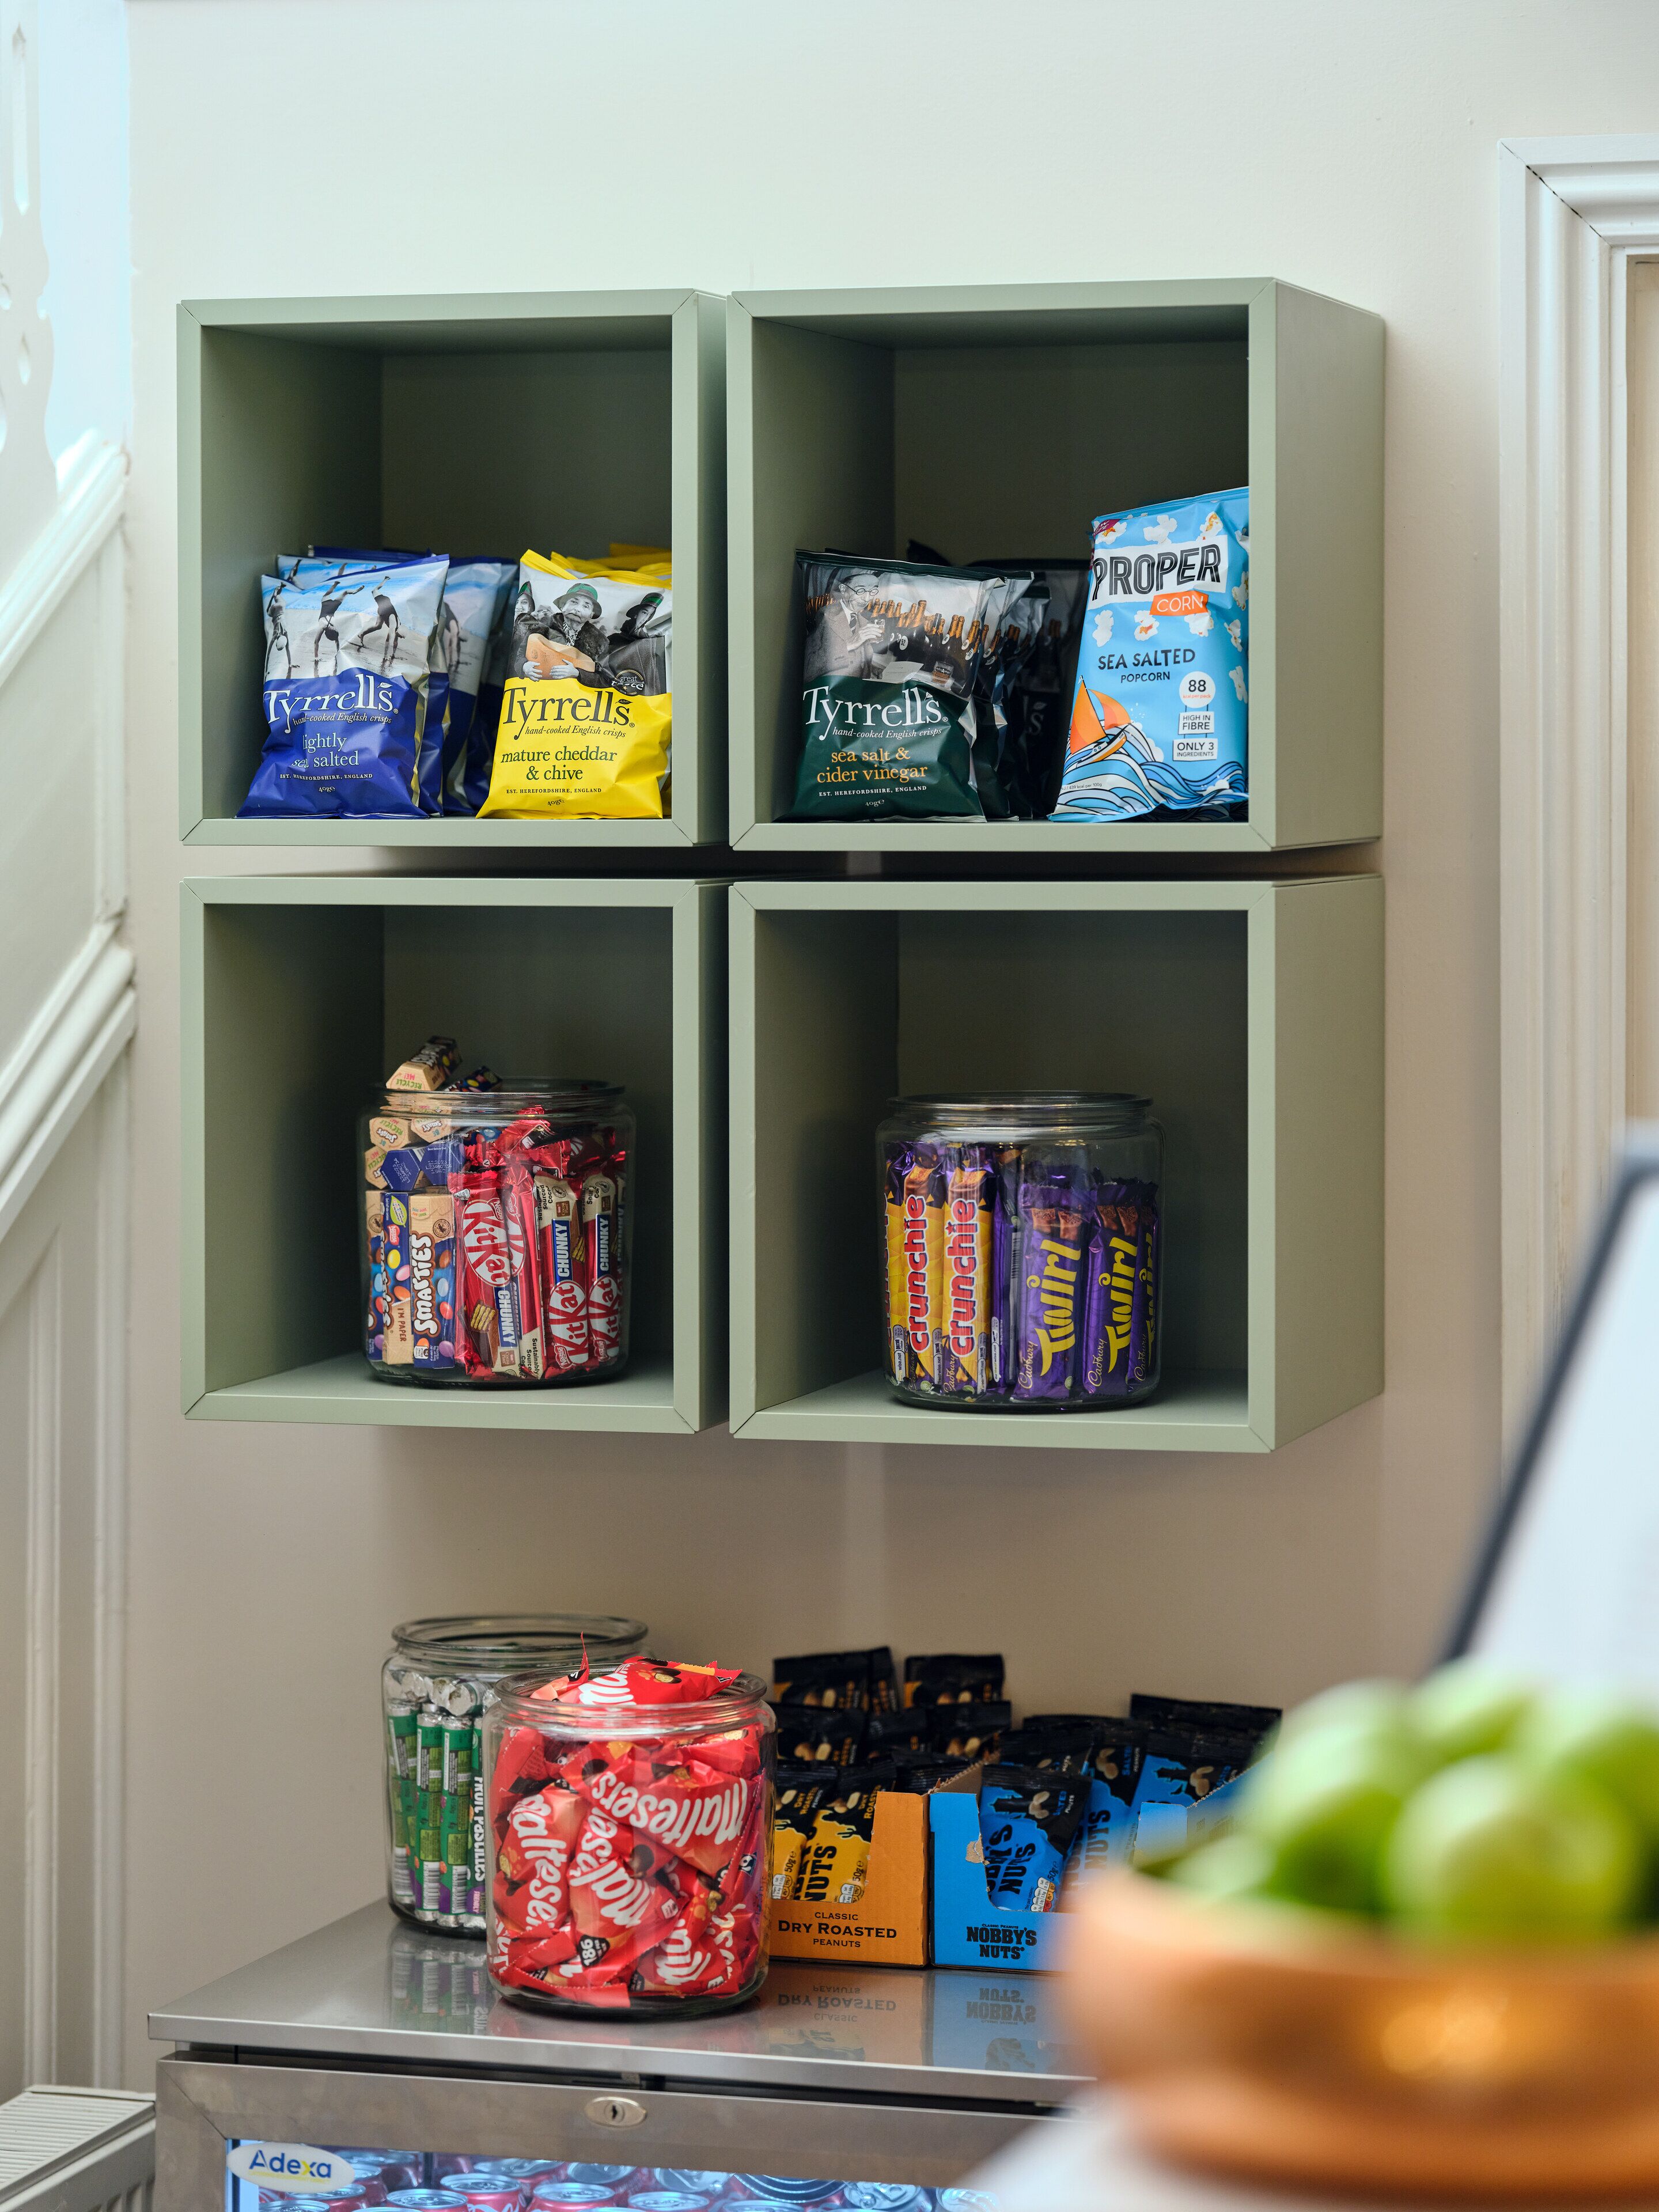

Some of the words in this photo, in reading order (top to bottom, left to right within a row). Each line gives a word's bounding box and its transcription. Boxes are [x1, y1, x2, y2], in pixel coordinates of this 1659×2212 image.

[1092, 544, 1221, 601] PROPER
[1157, 594, 1204, 614] CORN
[1099, 654, 1127, 670] SEA
[1132, 649, 1195, 667] SALTED
[1120, 672, 1170, 683] POPCORN
[1188, 680, 1206, 692] 88
[263, 673, 393, 734] Tyrrell's
[503, 687, 630, 740] Tyrrell's
[803, 686, 942, 741] Tyrrell's
[336, 713, 368, 725] English
[370, 714, 392, 725] crisps
[525, 725, 570, 735] hand-cooked
[571, 725, 601, 736] English
[604, 729, 626, 738] crisps
[832, 727, 884, 738] hand-cooked
[885, 729, 916, 740] English
[919, 728, 942, 736] crisps
[302, 732, 347, 753] lightly
[1177, 743, 1205, 751] ONLY
[1209, 742, 1214, 750] 3
[291, 757, 309, 768] sea
[313, 751, 359, 768] salted
[501, 749, 550, 763] mature
[555, 745, 618, 762] cheddar
[831, 751, 857, 763] sea
[862, 748, 890, 762] salt
[895, 747, 911, 760] &
[526, 766, 539, 780] &
[544, 765, 583, 780] chive
[817, 767, 858, 783] cider
[862, 764, 928, 783] vinegar
[396, 1079, 422, 1089] RECYCLE
[555, 1224, 570, 1277] CHUNKY
[600, 1218, 609, 1271] CHUNKY
[411, 1234, 438, 1334] SMARTIES
[1027, 1239, 1081, 1377] Twirl
[1098, 1237, 1138, 1373] Twirl
[498, 1290, 516, 1344] CHUNKY
[398, 1318, 407, 1342] PAPER
[1018, 1340, 1038, 1390] Cadbury
[1088, 1338, 1107, 1388] Cadbury
[1122, 1746, 1132, 1776] SALTED
[592, 1771, 748, 1847] Maltesers
[785, 1858, 796, 1872] 50g
[805, 1846, 837, 1901] NUTS
[853, 1867, 864, 1881] 50g
[1047, 1869, 1059, 1881] 50g
[815, 1912, 858, 1920] CLASSIC
[778, 1920, 813, 1933] DRY
[818, 1922, 897, 1938] ROASTED
[967, 1926, 1037, 1946] NOBBY'S
[581, 1938, 597, 1966] 186
[813, 1938, 861, 1947] PEANUTS
[979, 1944, 1021, 1960] NUTS
[249, 2149, 331, 2179] Adexa
